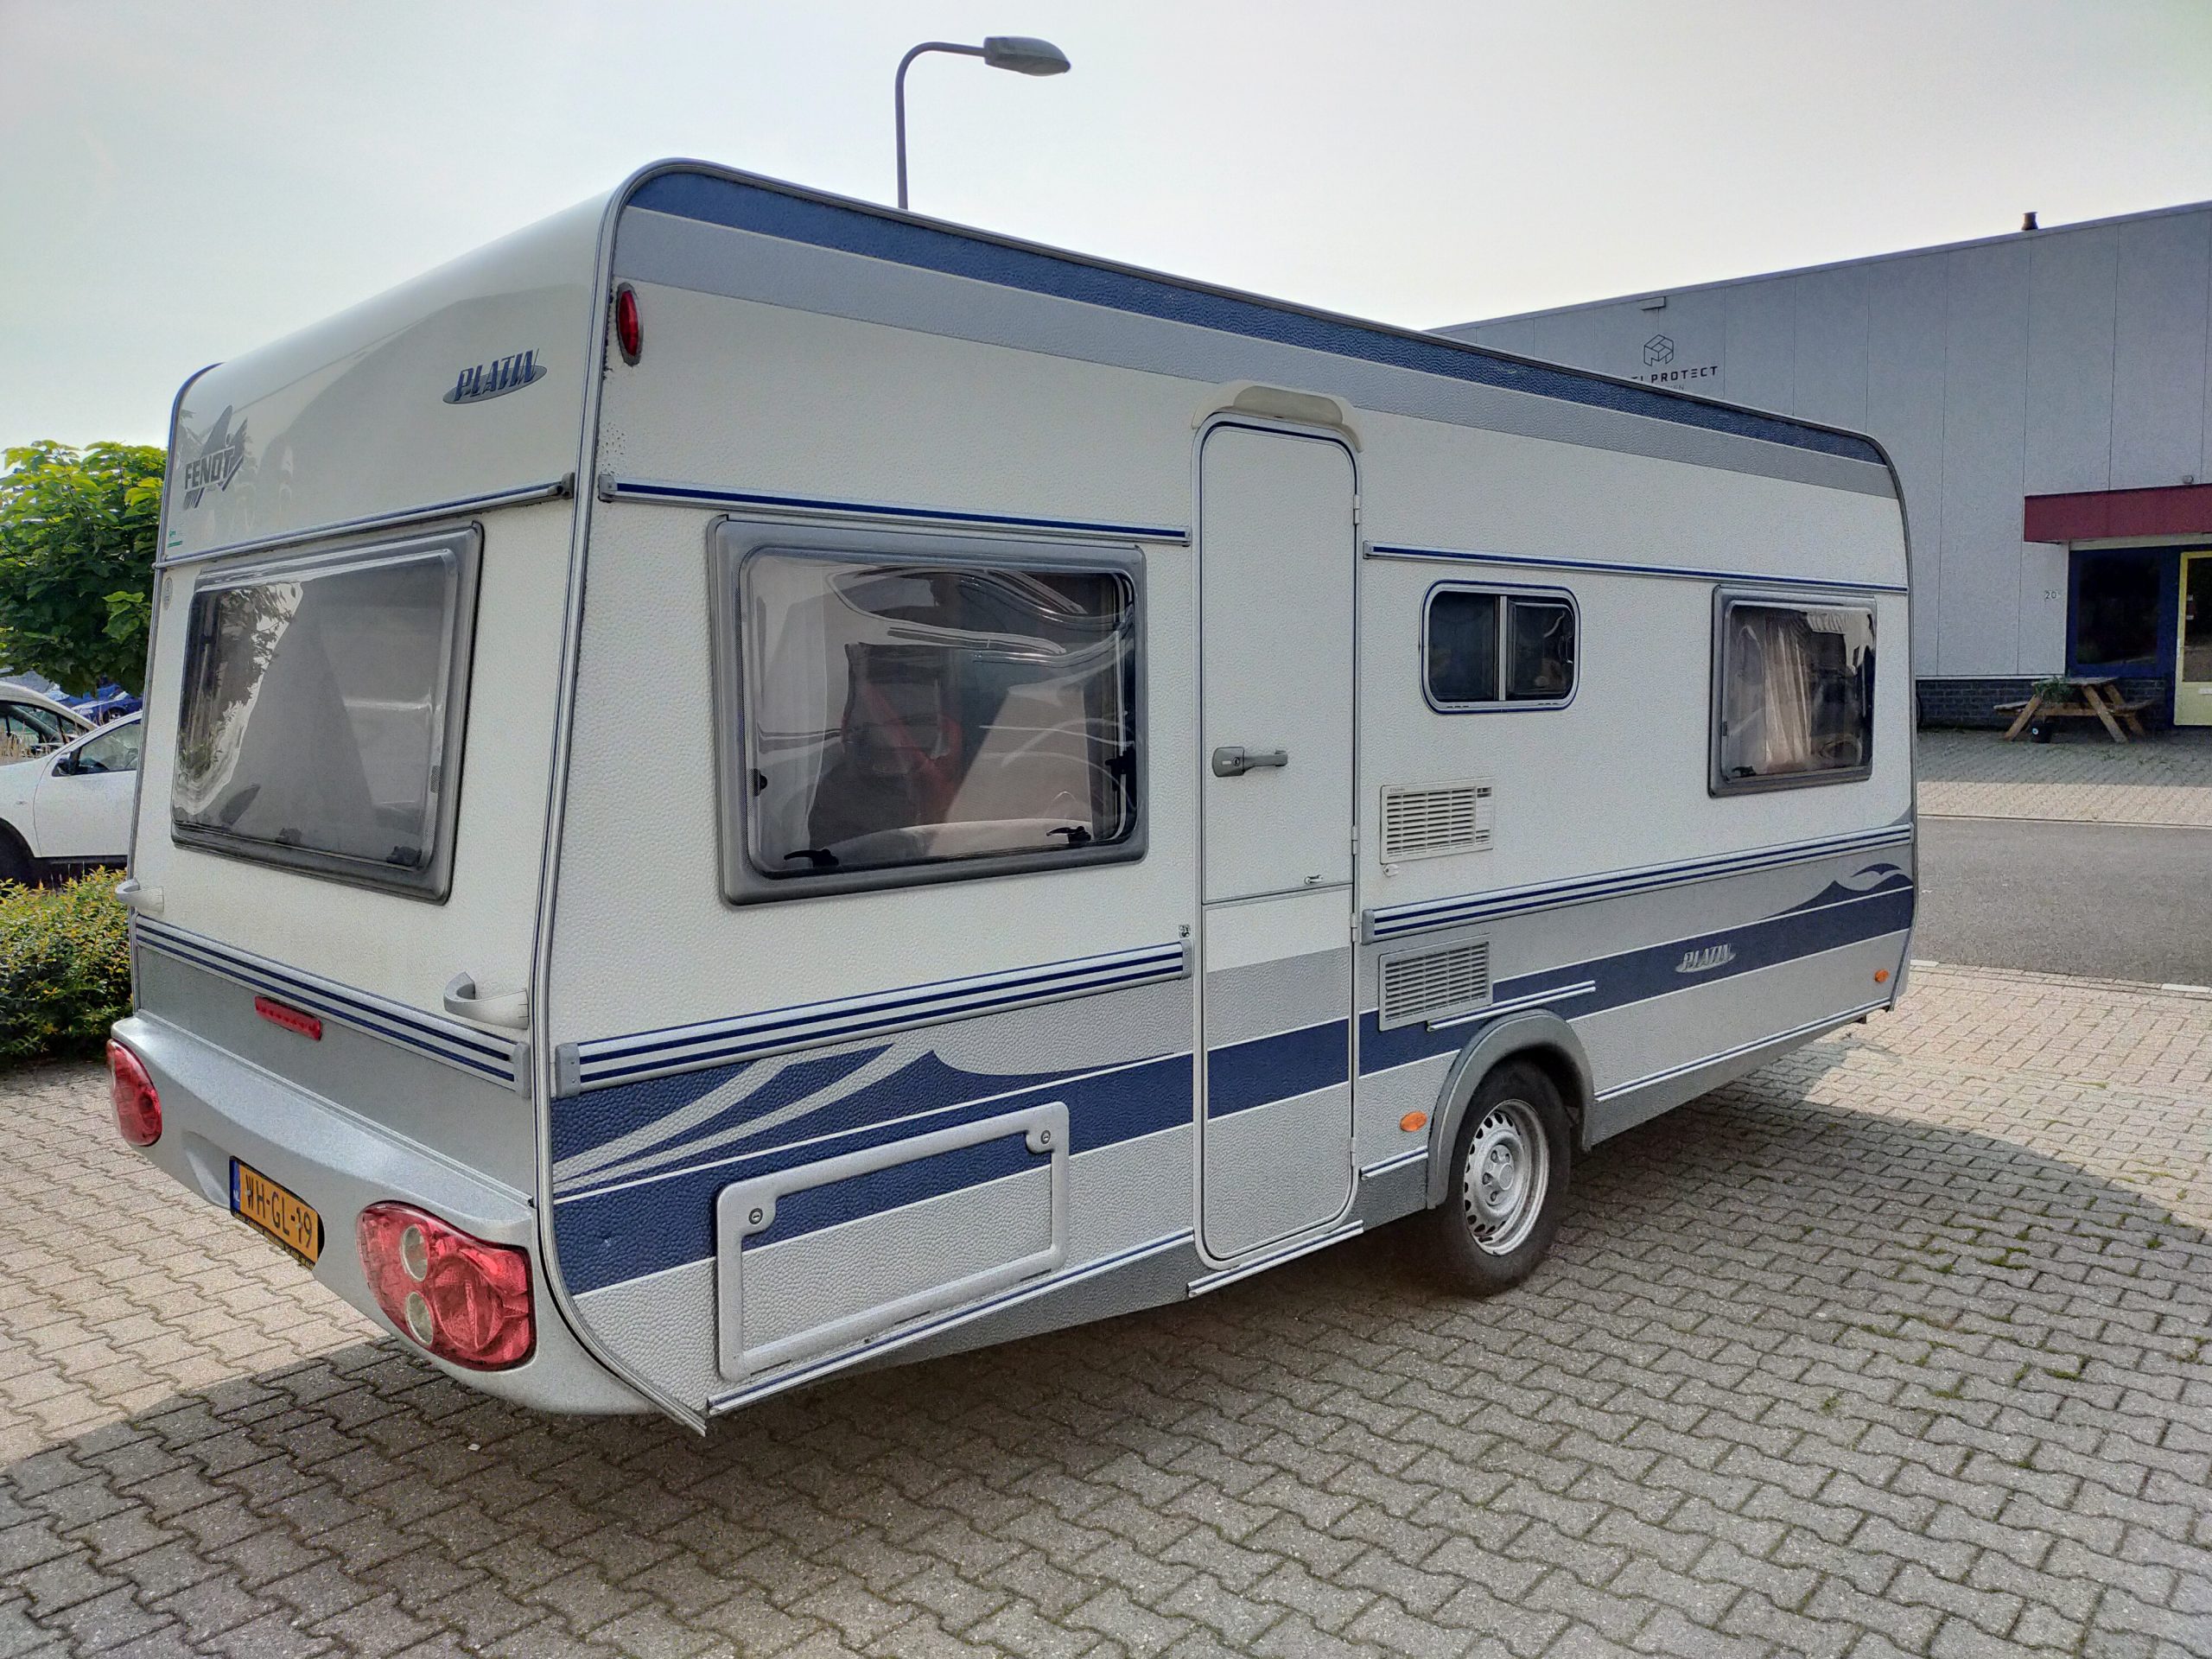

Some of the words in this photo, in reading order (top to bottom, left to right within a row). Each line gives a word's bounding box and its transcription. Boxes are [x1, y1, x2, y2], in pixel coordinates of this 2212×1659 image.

[454, 347, 540, 402] PLATIN
[1650, 365, 1718, 384] PROTECT
[184, 448, 234, 490] FENDT
[2045, 591, 2057, 600] 20
[1681, 944, 1732, 970] PLATIN
[245, 1173, 313, 1249] WH-GL-19
